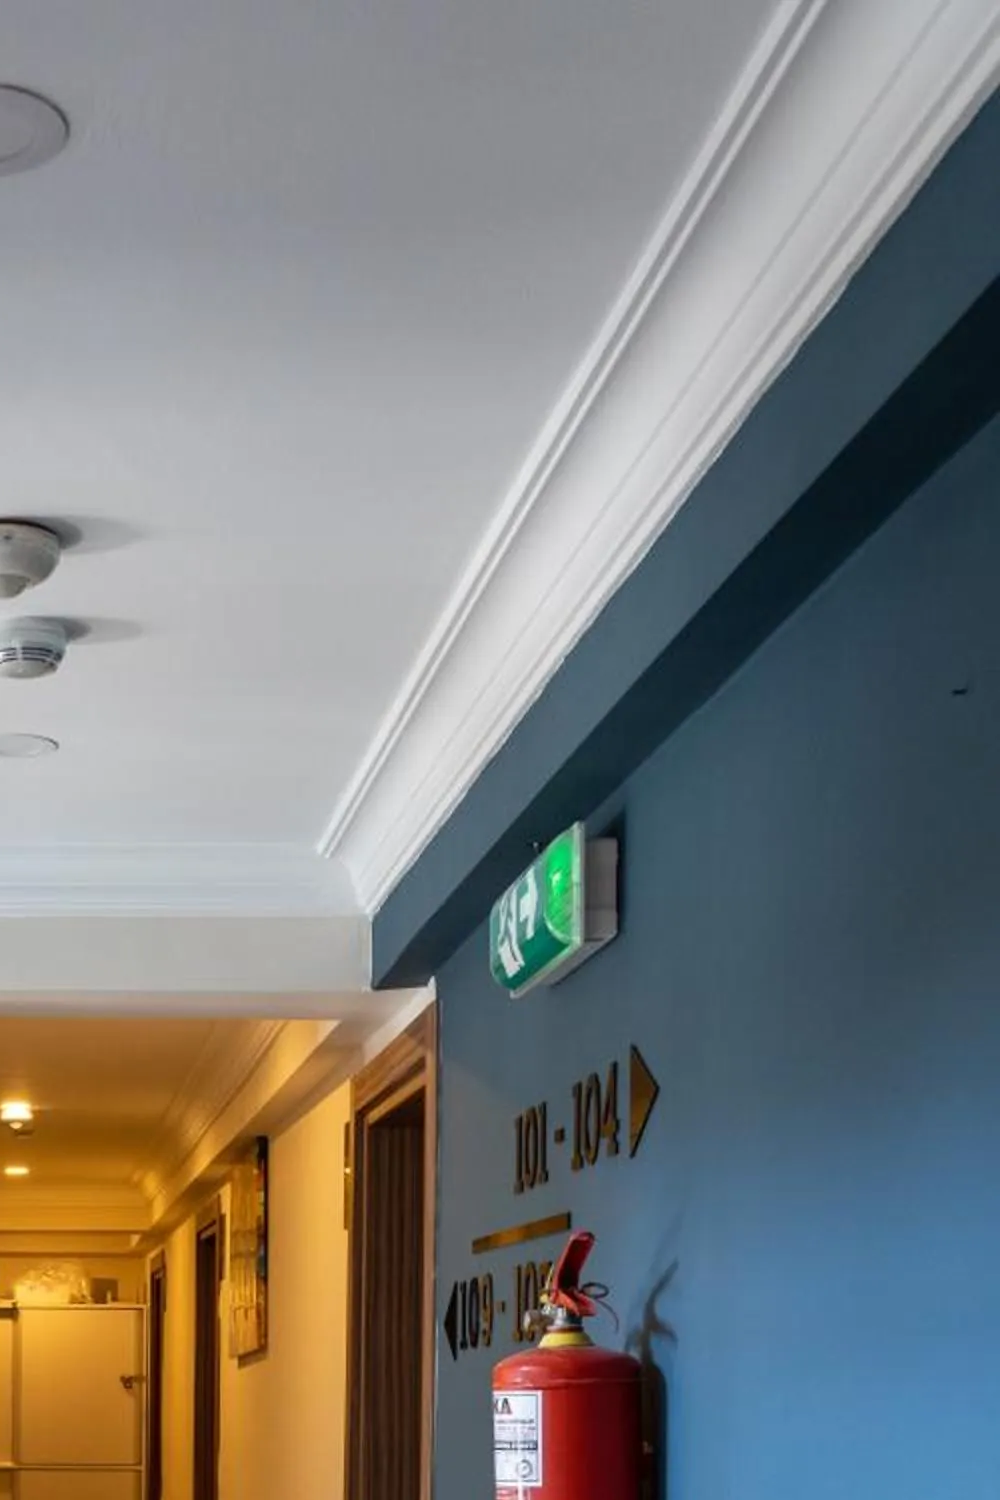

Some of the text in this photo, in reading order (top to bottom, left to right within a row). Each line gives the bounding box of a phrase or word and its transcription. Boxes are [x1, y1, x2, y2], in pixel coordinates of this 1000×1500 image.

[514, 1101, 549, 1194] 101
[571, 1060, 620, 1171] 104
[459, 1273, 493, 1350] 109
